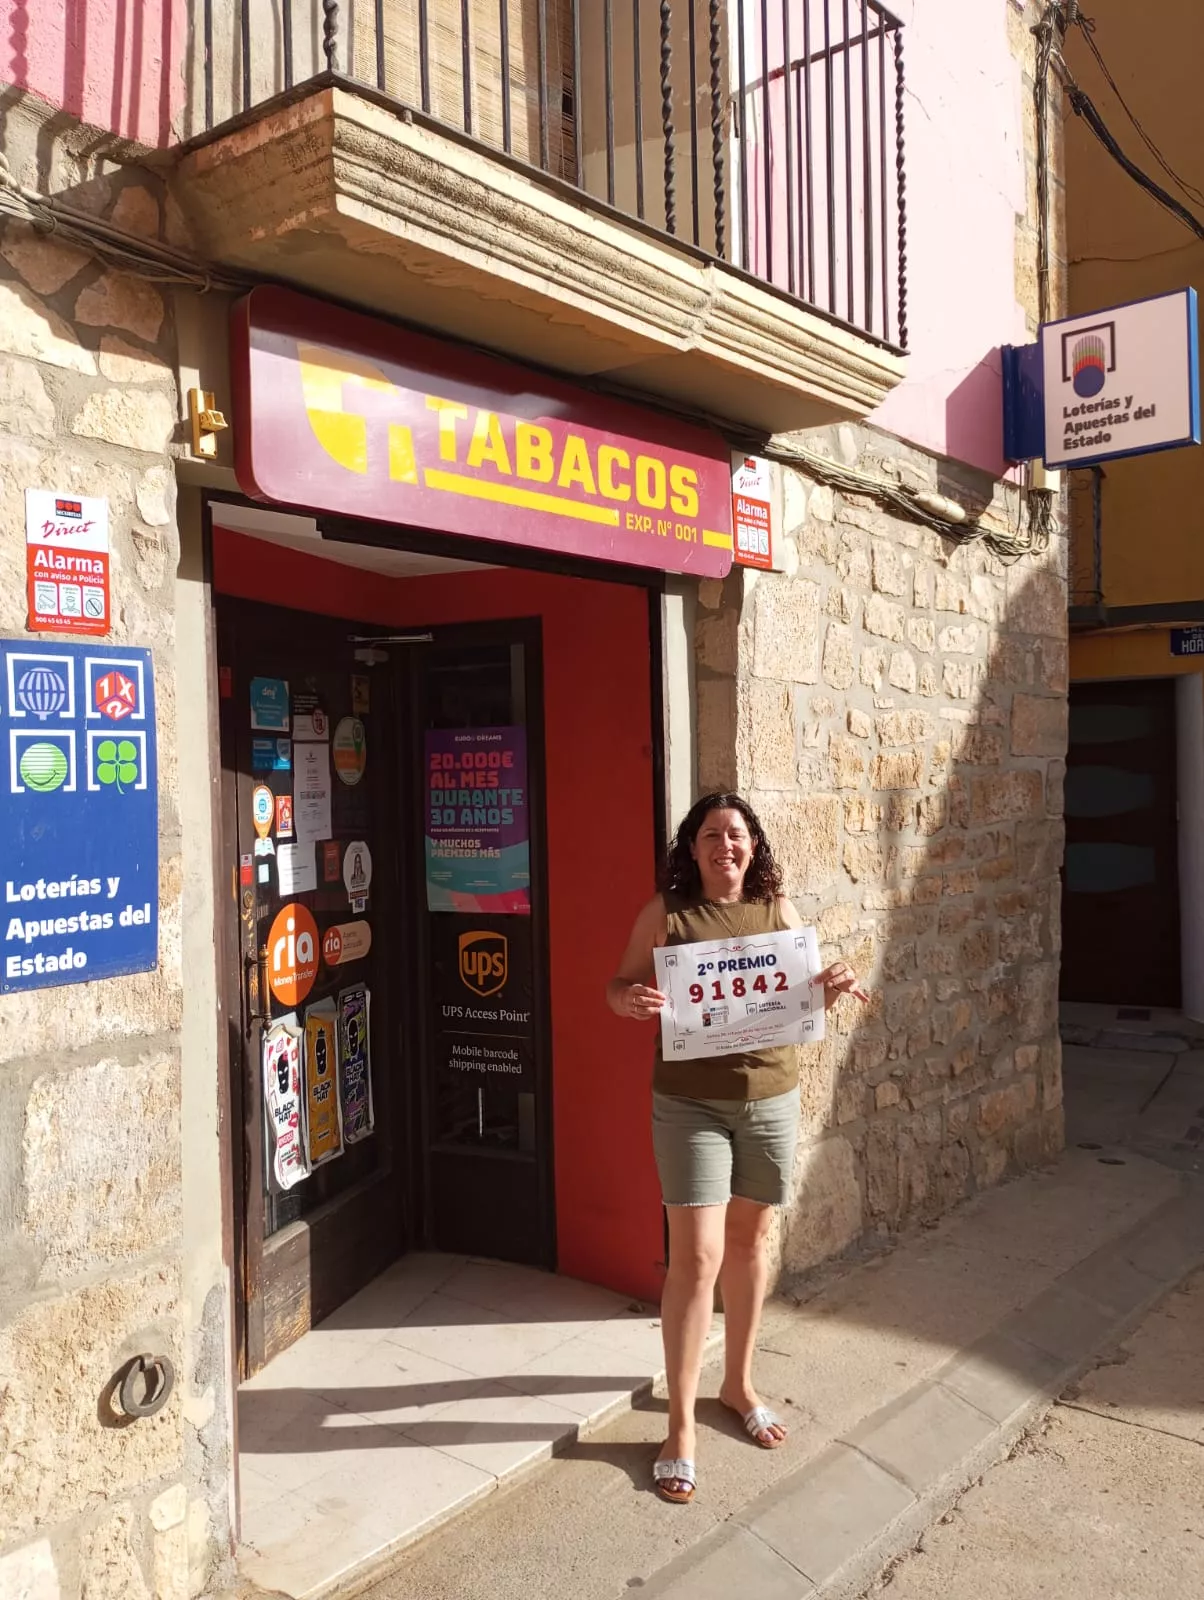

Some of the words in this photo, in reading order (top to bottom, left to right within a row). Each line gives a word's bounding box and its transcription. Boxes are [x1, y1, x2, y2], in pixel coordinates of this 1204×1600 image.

[1063, 397, 1121, 419] Loterías
[1124, 395, 1134, 409] y
[1064, 412, 1130, 435] Apuestas
[1133, 403, 1156, 421] del
[1063, 430, 1112, 450] Estado
[425, 394, 699, 518] TABACOS
[736, 499, 768, 519] Alarma
[41, 520, 97, 539] Direct
[625, 512, 655, 535] EXP.
[675, 524, 698, 543] 001
[34, 549, 104, 574] Alarma
[34, 570, 49, 579] con
[50, 572, 71, 581] aviso
[430, 751, 514, 770] 20.000€
[430, 772, 456, 788] AL
[460, 770, 499, 788] MES
[430, 788, 524, 807] DURANTE
[430, 808, 456, 825] 30
[460, 803, 514, 825] AÑOS
[430, 839, 440, 848] Y
[441, 839, 481, 849] MUCHOS
[431, 848, 477, 858] PREMIOS
[480, 846, 501, 859] MÁS
[6, 874, 102, 903] Loterías
[107, 876, 121, 899] y
[5, 910, 114, 944] Apuestas
[119, 902, 151, 927] del
[273, 917, 314, 972] ria
[325, 932, 340, 953] ria
[6, 947, 88, 978] Estado
[463, 951, 504, 986] ups
[697, 961, 714, 977] 2º
[717, 953, 778, 974] PREMIO
[442, 1005, 463, 1018] UPS
[465, 1007, 498, 1020] Access
[758, 1005, 787, 1014] NACIONAL
[452, 1045, 482, 1057] Mobile
[483, 1047, 519, 1060] barcode
[345, 1060, 364, 1076] BLACK
[449, 1059, 487, 1073] shipping
[487, 1062, 522, 1074] enabled
[313, 1080, 332, 1097] BLACK
[316, 1089, 329, 1103] HAT
[274, 1101, 295, 1118] BLACK
[278, 1110, 292, 1124] HAT
